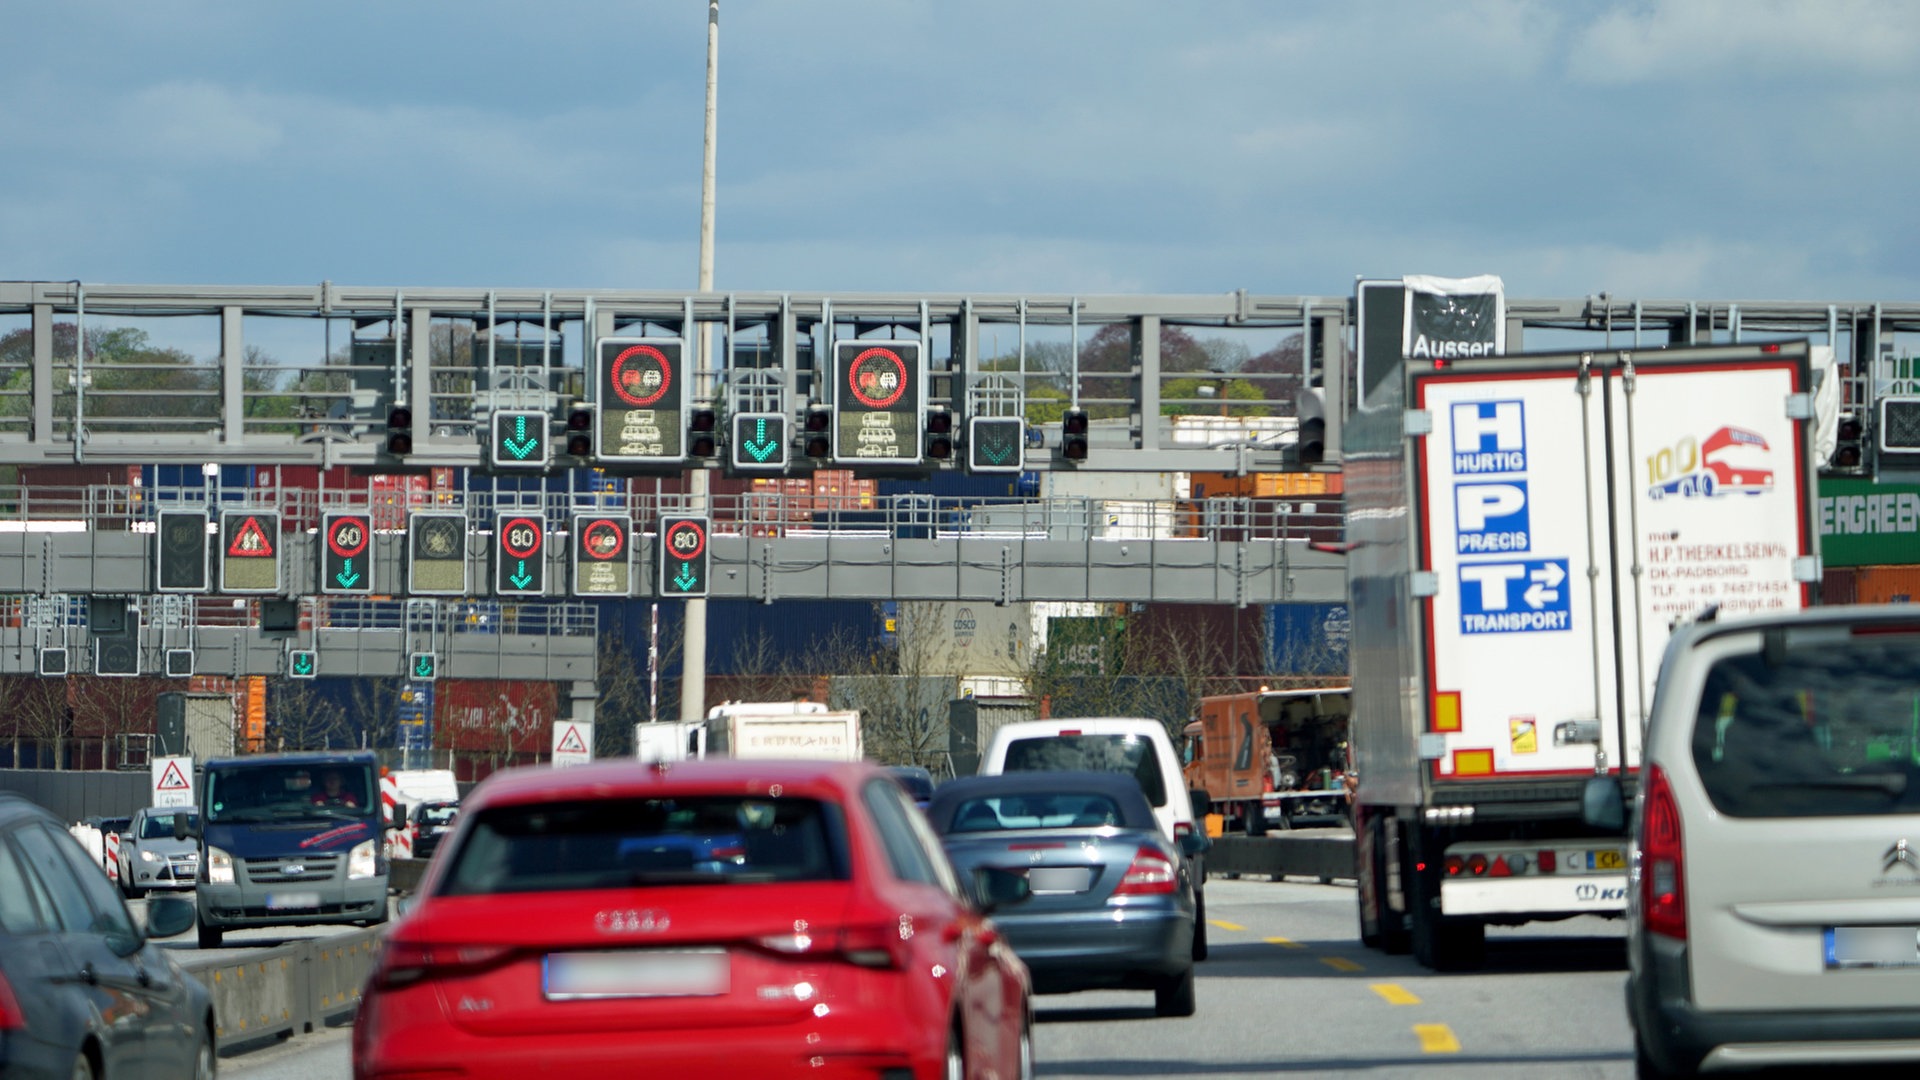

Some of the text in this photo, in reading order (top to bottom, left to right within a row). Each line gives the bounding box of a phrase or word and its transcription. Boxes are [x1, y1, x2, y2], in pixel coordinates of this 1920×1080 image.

[1413, 333, 1495, 358] Ausser
[1452, 403, 1523, 453] H
[1455, 451, 1525, 473] HURTIG
[1646, 434, 1698, 486] 100
[1456, 483, 1526, 532] P
[336, 527, 361, 546] 60
[510, 528, 534, 547] 80
[674, 531, 698, 549] 80
[1458, 531, 1529, 553] PRÆCIS
[953, 619, 976, 630] COSCO
[1463, 611, 1569, 634] TRANSPORT
